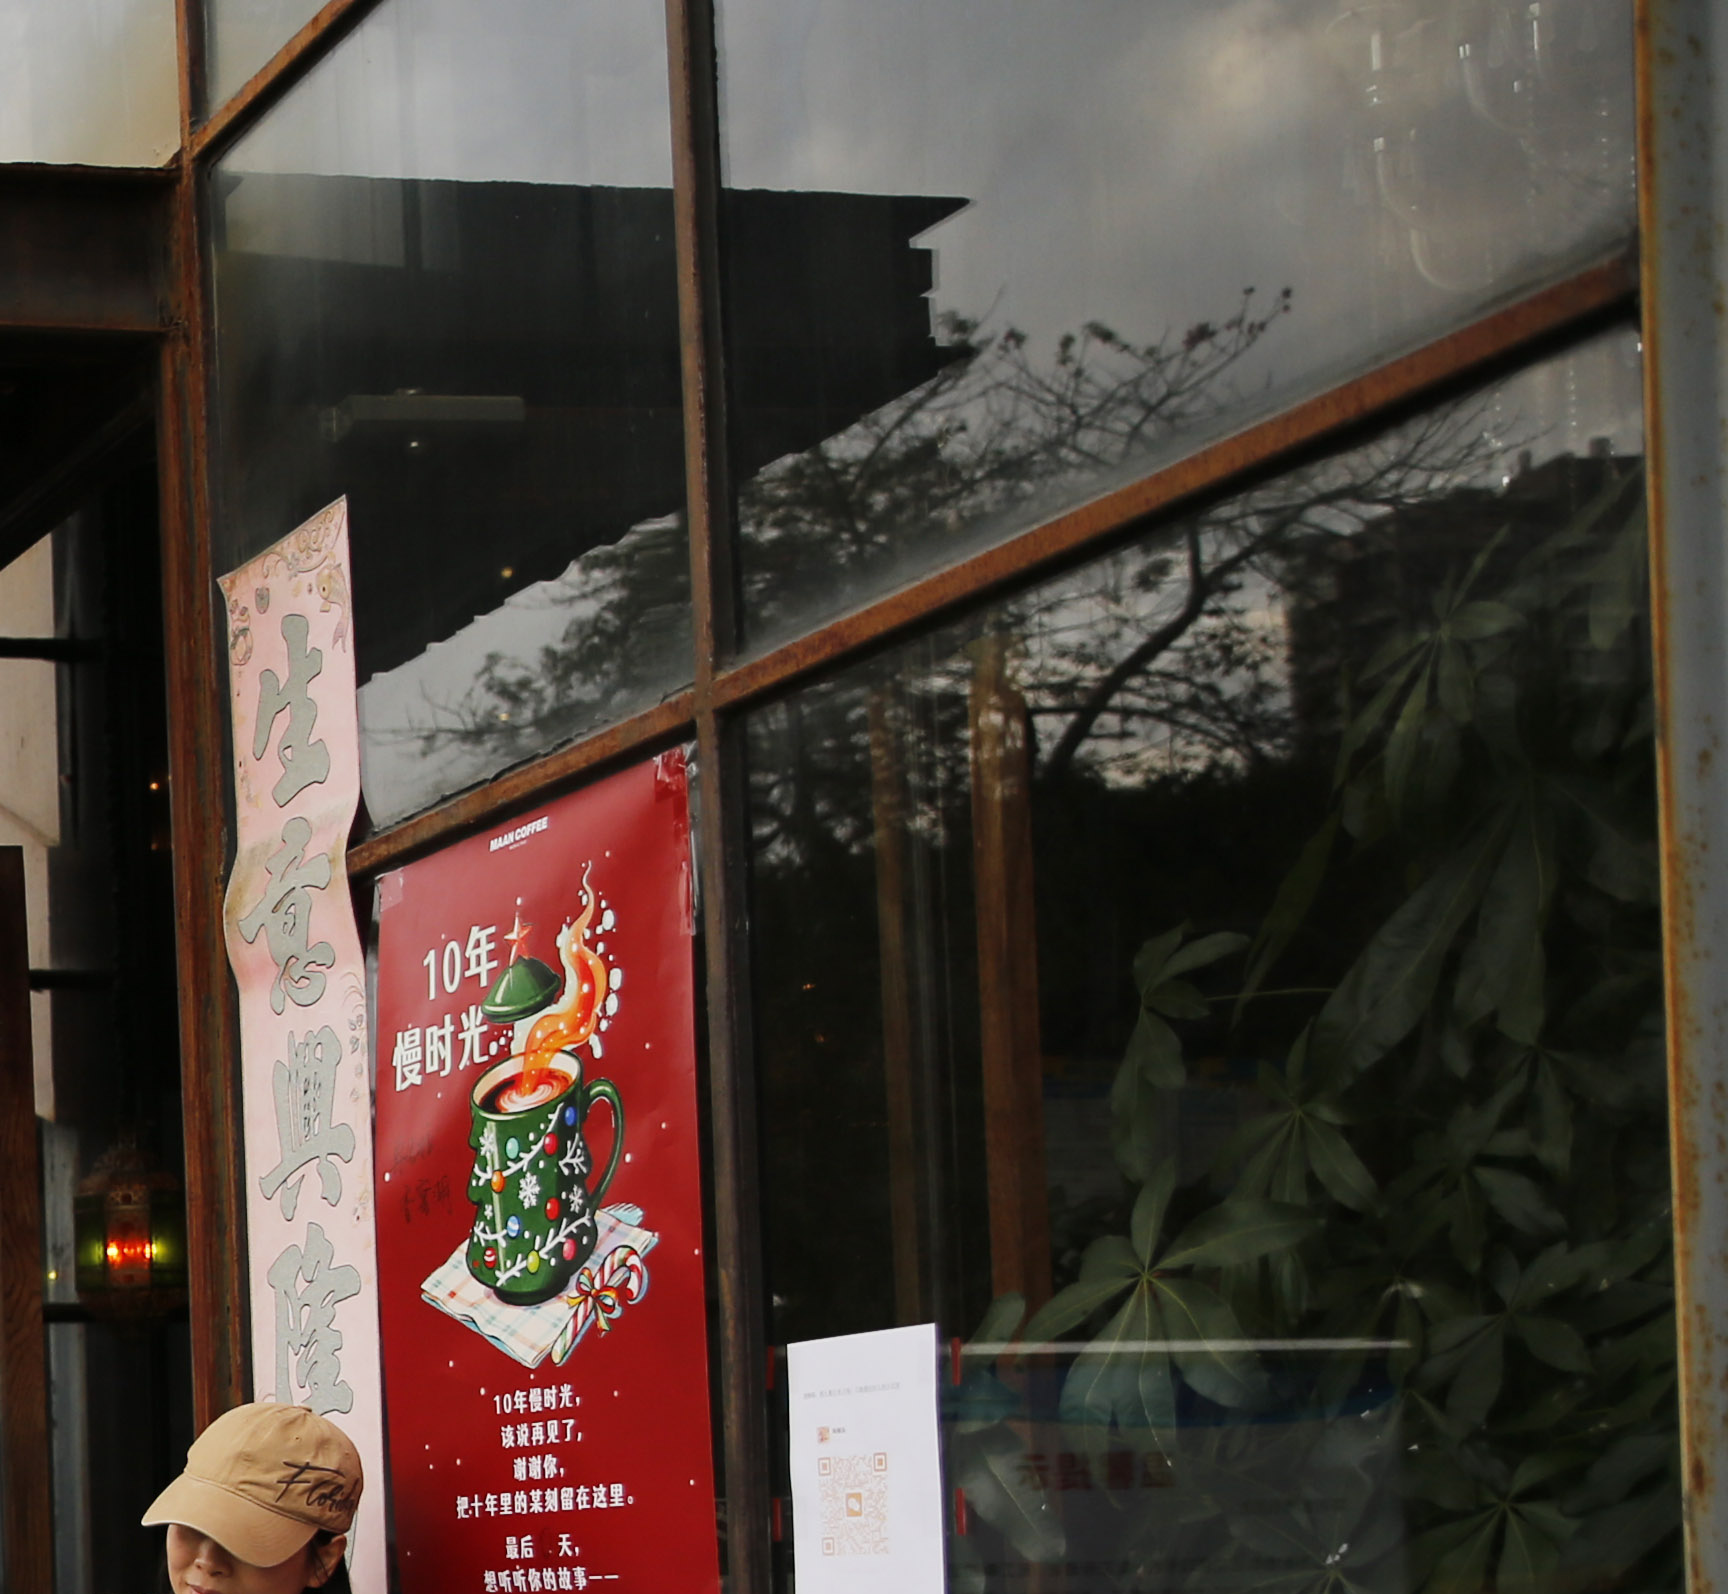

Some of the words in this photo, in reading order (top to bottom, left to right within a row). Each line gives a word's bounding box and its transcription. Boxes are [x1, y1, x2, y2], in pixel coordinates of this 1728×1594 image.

[489, 830, 514, 852] MAAN
[514, 816, 549, 842] COFFEE
[423, 925, 499, 1001] 10年
[392, 1004, 489, 1092] 慢时光
[505, 1535, 534, 1559] 最后
